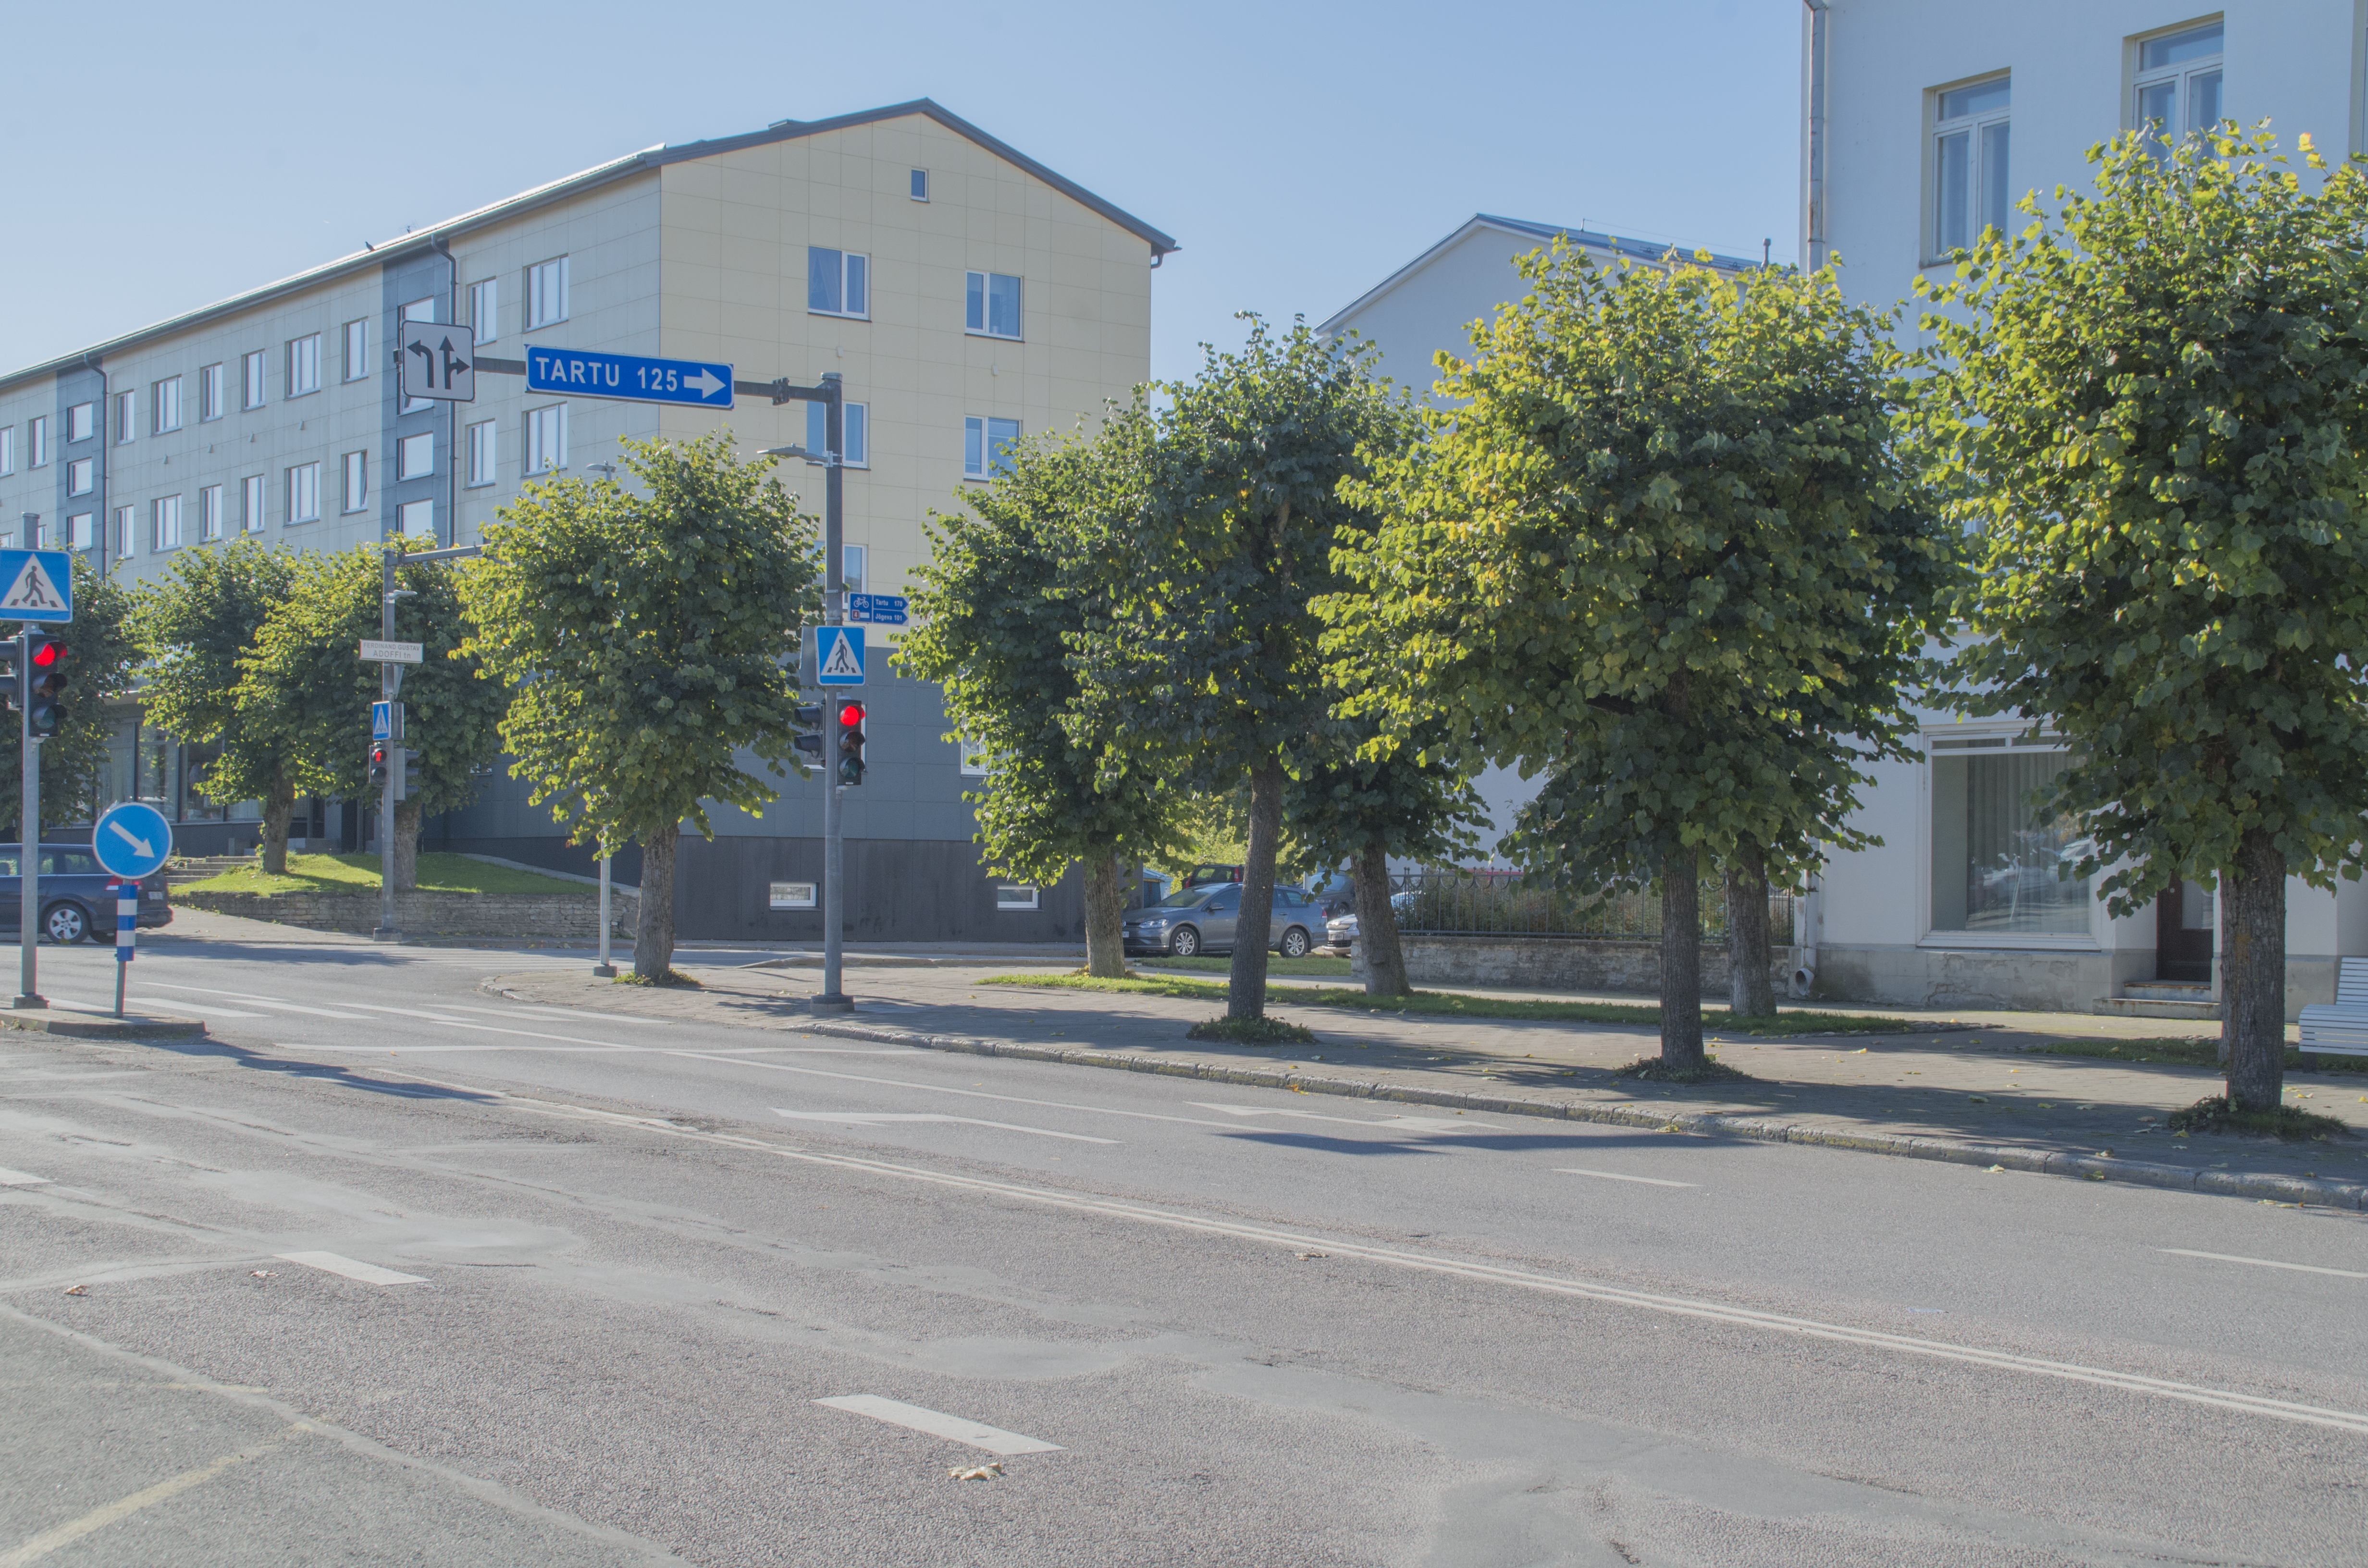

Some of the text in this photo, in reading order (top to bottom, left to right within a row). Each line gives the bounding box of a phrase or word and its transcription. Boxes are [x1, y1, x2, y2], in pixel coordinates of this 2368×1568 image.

[535, 356, 678, 392] TARTU 125
[373, 650, 402, 658] ADOFFI
